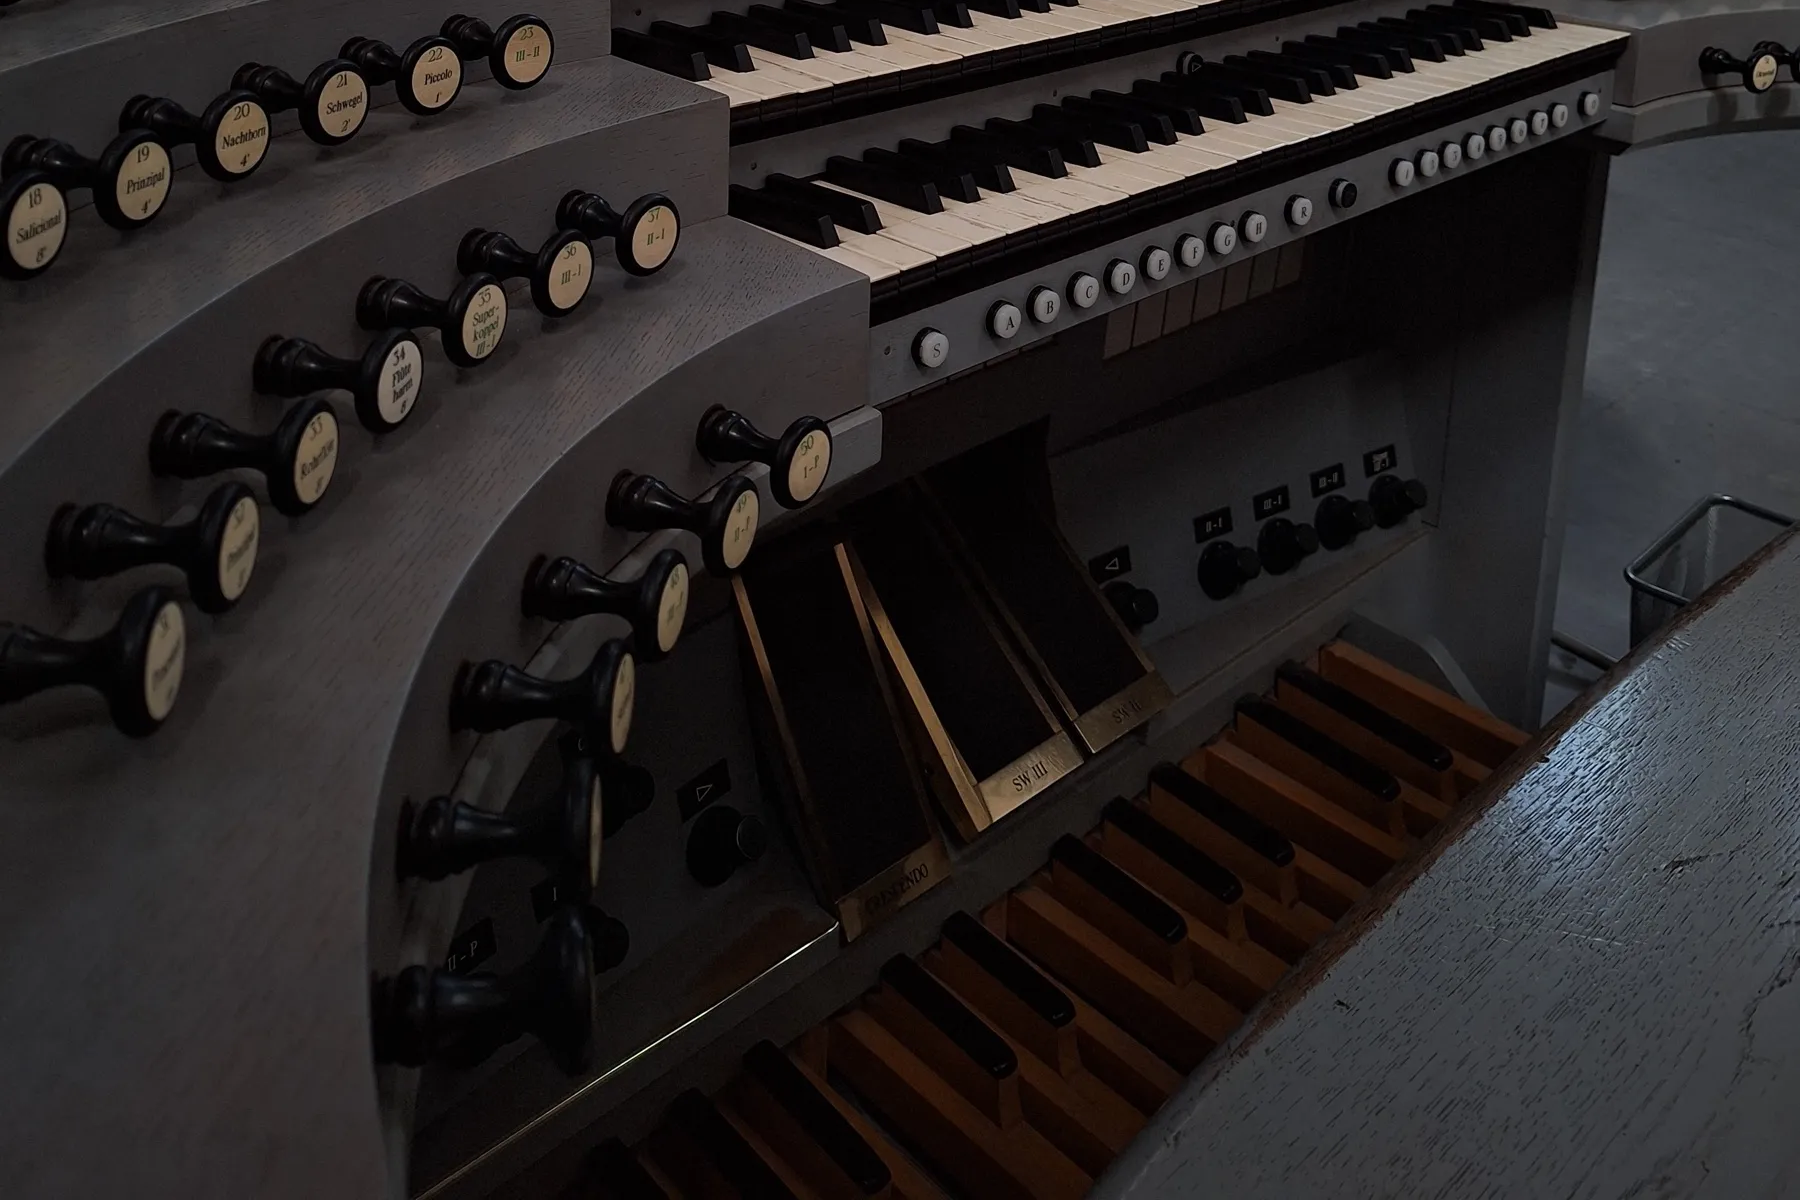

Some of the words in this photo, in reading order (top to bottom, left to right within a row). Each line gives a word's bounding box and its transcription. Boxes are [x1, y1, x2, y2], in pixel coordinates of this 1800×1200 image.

[519, 26, 534, 41] 23
[427, 47, 443, 62] 22
[336, 74, 348, 89] 21
[424, 68, 453, 86] Piccolo
[326, 91, 364, 115] Schwegel
[233, 103, 250, 121] 20
[221, 125, 266, 150] Nachthorn
[136, 145, 150, 164] 19
[126, 167, 165, 195] Prinzipal
[29, 187, 43, 209] 18
[1300, 206, 1308, 219] R
[16, 208, 62, 245] Salicional
[1255, 222, 1263, 235] H
[1224, 234, 1231, 247] G
[1192, 246, 1200, 260] F
[1158, 259, 1165, 273] E
[1122, 272, 1131, 286] D
[1085, 285, 1094, 299] C
[1045, 300, 1054, 315] B
[472, 306, 500, 327] Super-
[1005, 315, 1015, 331] A
[472, 315, 500, 343] koppel
[932, 343, 941, 358] S
[1012, 770, 1032, 792] SW
[1031, 760, 1048, 779] III
